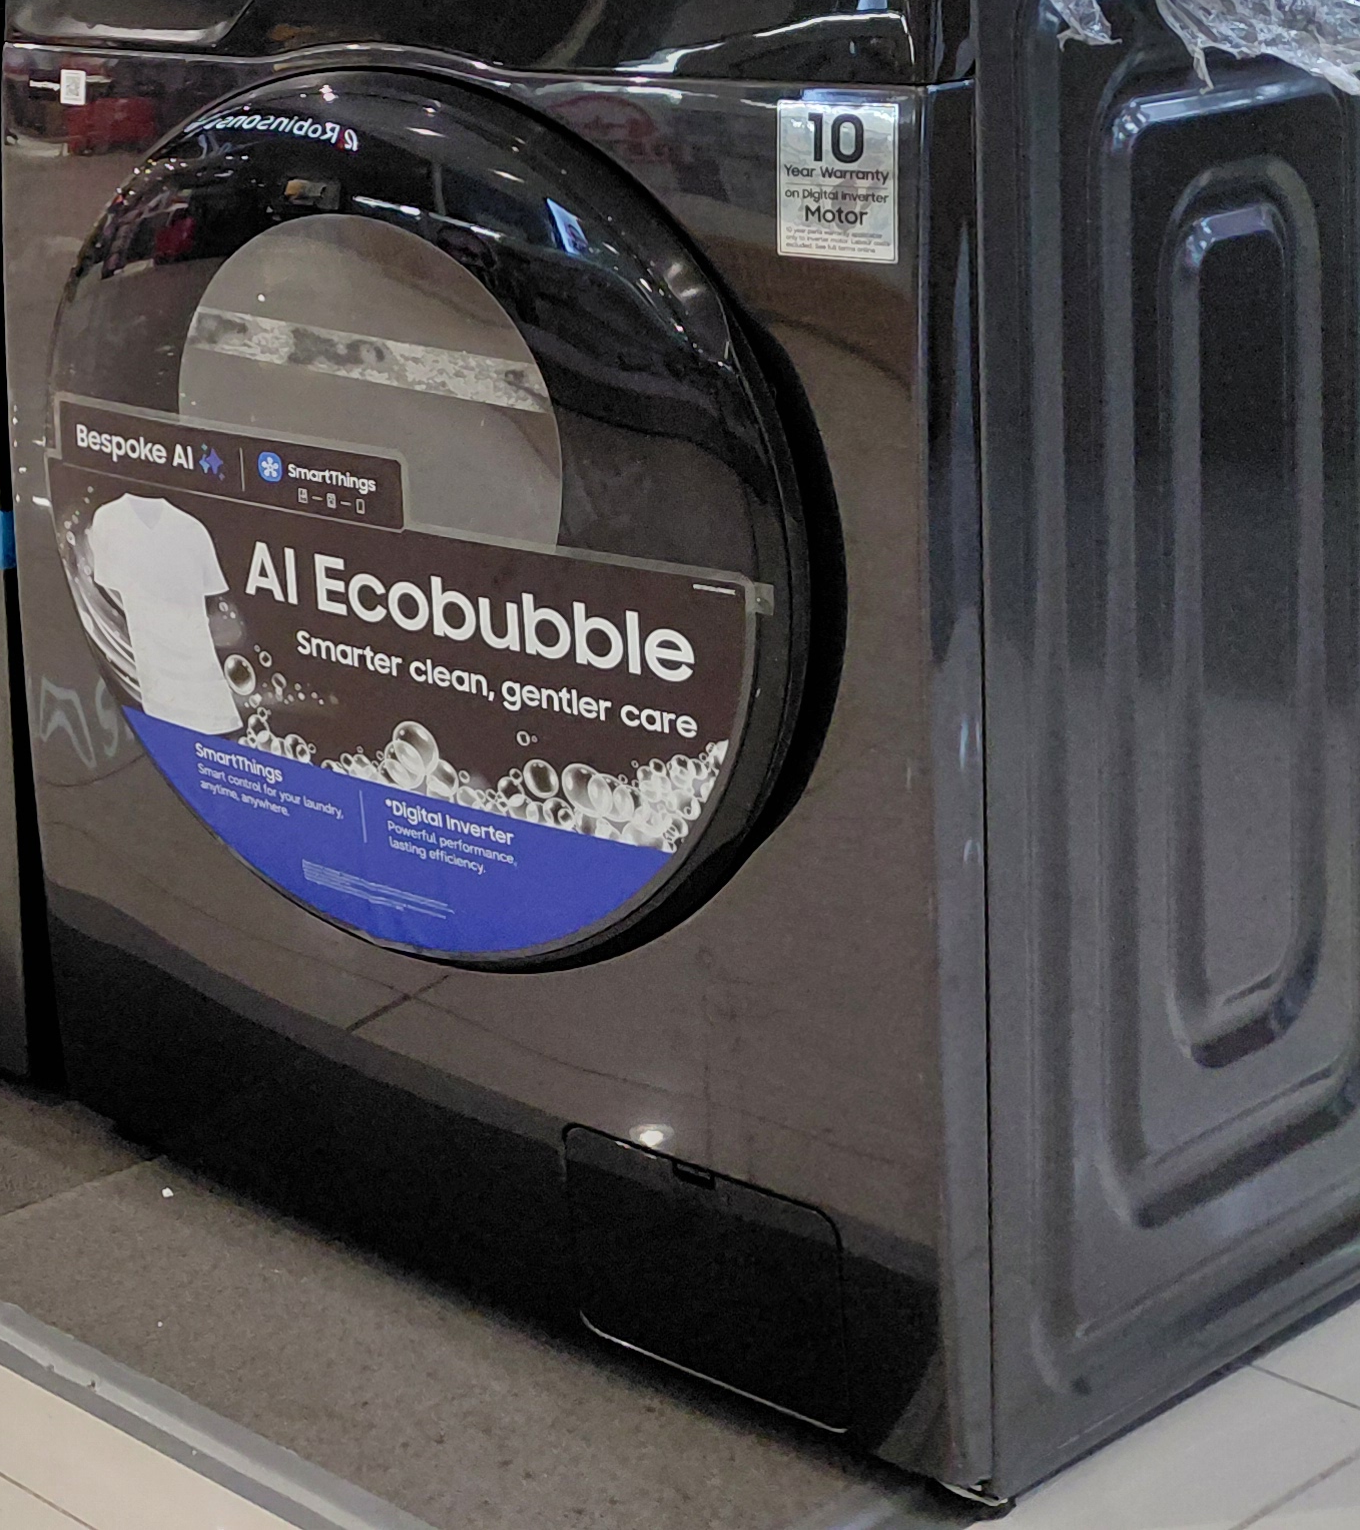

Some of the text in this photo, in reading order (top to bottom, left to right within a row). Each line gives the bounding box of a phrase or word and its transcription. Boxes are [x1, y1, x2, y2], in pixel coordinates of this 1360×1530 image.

[807, 112, 865, 165] 10
[783, 163, 890, 186] Year Warranty
[784, 188, 890, 205] on Digital Inverter
[804, 204, 869, 226] Motor
[75, 423, 195, 471] Bespoke AI
[287, 461, 377, 495] SmartThings
[244, 540, 696, 683] AI Ecobubble
[295, 628, 699, 740] Smarter clean, gentler care
[194, 741, 284, 785] SmartThings
[197, 762, 227, 782] Smart
[227, 775, 263, 794] control
[263, 783, 278, 798] for
[279, 790, 302, 806] your
[387, 819, 438, 845] Powerful
[445, 813, 515, 846] Inverter
[388, 836, 486, 876] lasting efficiency.
